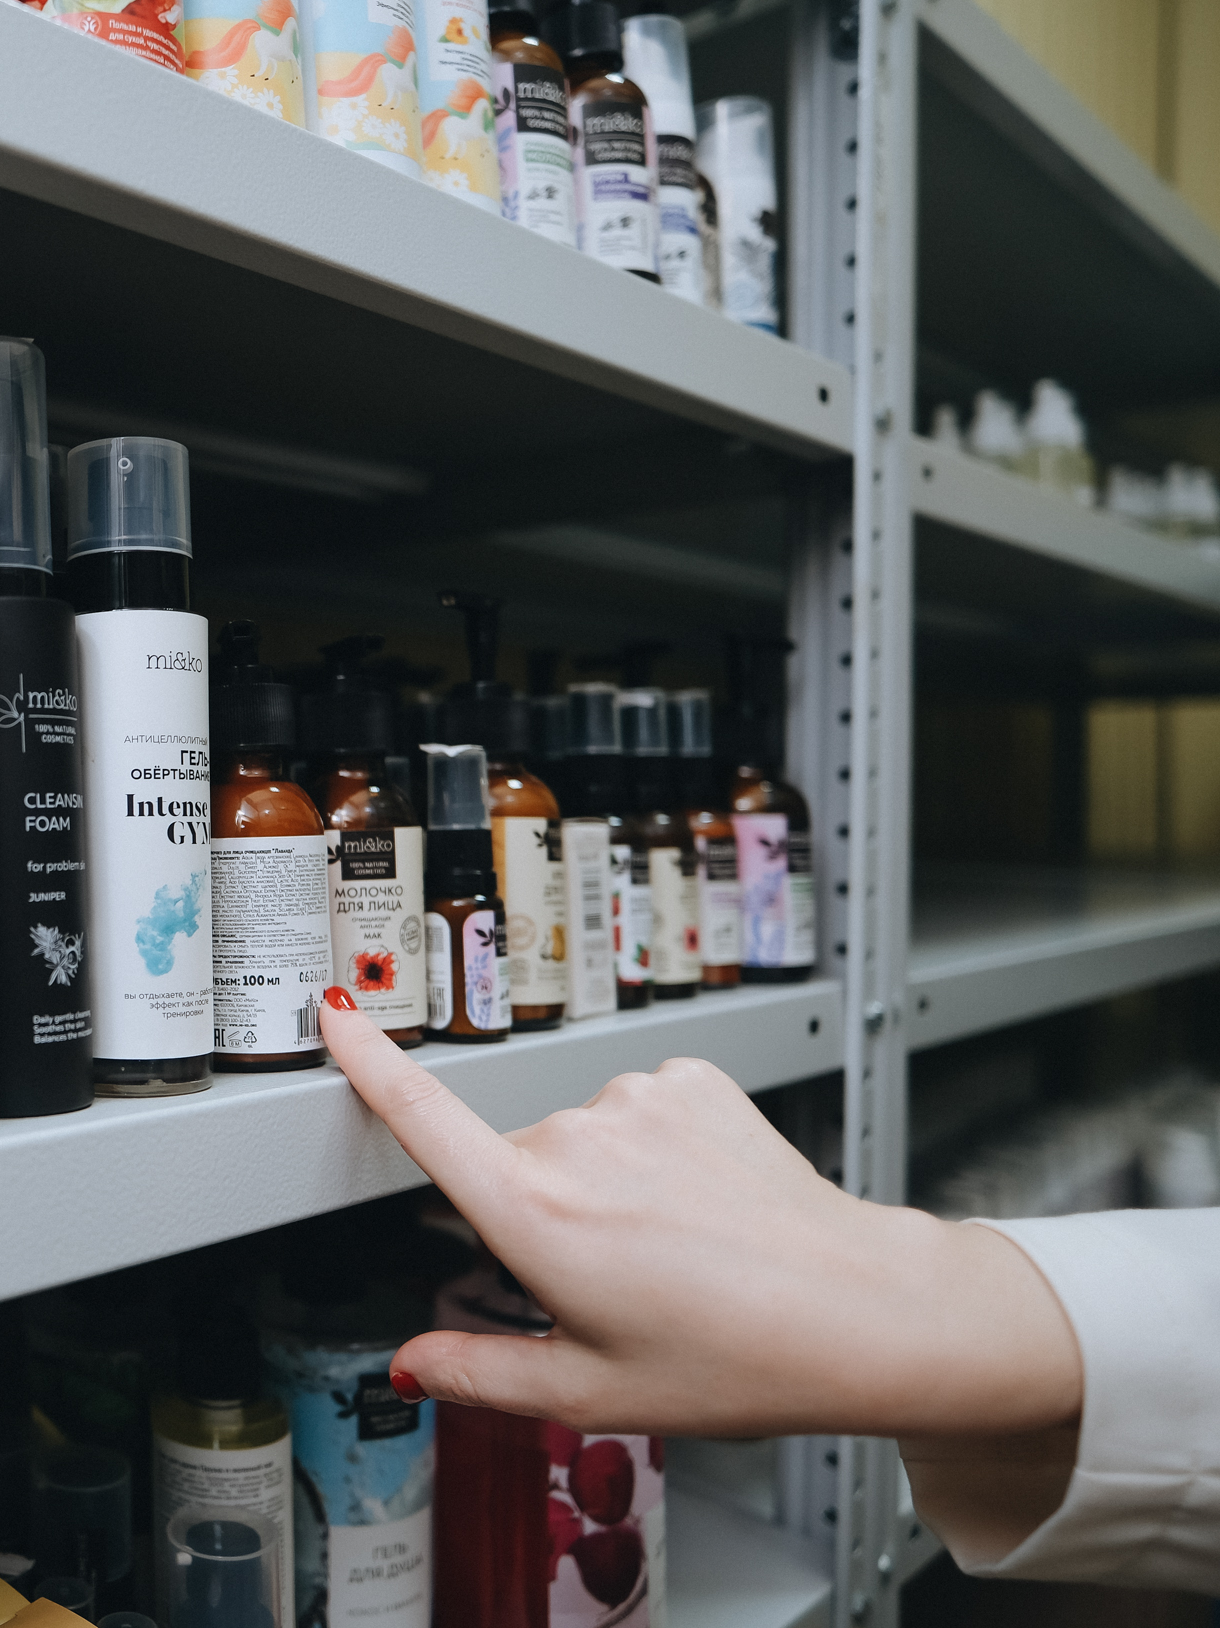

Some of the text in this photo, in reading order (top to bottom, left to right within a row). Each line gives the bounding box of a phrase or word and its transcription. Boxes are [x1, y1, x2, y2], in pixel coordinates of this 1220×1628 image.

[108, 19, 136, 32] Польза
[137, 26, 142, 34] и
[108, 32, 124, 40] для
[124, 34, 147, 47] сухой,
[146, 650, 203, 673] mi&ko
[26, 688, 78, 712] mi&ko
[34, 724, 54, 734] 100%
[41, 734, 75, 745] COSMETICS
[180, 750, 210, 767] ГЕЛЬ-
[130, 766, 210, 782] ОБЁРТЫВАНИЕ
[24, 792, 84, 809] CLEANSIN
[125, 794, 208, 818] Intense
[25, 816, 71, 832] FOAM
[167, 821, 211, 845] GYM
[344, 836, 393, 854] mi&ko
[27, 860, 45, 873] for
[46, 860, 80, 874] problem
[354, 868, 386, 876] COSMETICS
[28, 891, 66, 903] JUNIPER
[334, 885, 403, 899] МОЛОЧКО
[337, 900, 403, 914] ДЛЯ ЛИЦА
[364, 932, 382, 940] МАК
[213, 976, 241, 986] БЪЕМ:
[243, 975, 265, 986] 100
[138, 992, 184, 1000] отдыхаете,
[150, 1001, 180, 1010] эффект
[194, 998, 209, 1006] после
[33, 1014, 54, 1026] Daily
[54, 1012, 75, 1024] gentle
[162, 1009, 204, 1020] тренировки
[33, 1024, 65, 1035] Soothes
[65, 1022, 75, 1031] the
[34, 1032, 77, 1045] Balances the
